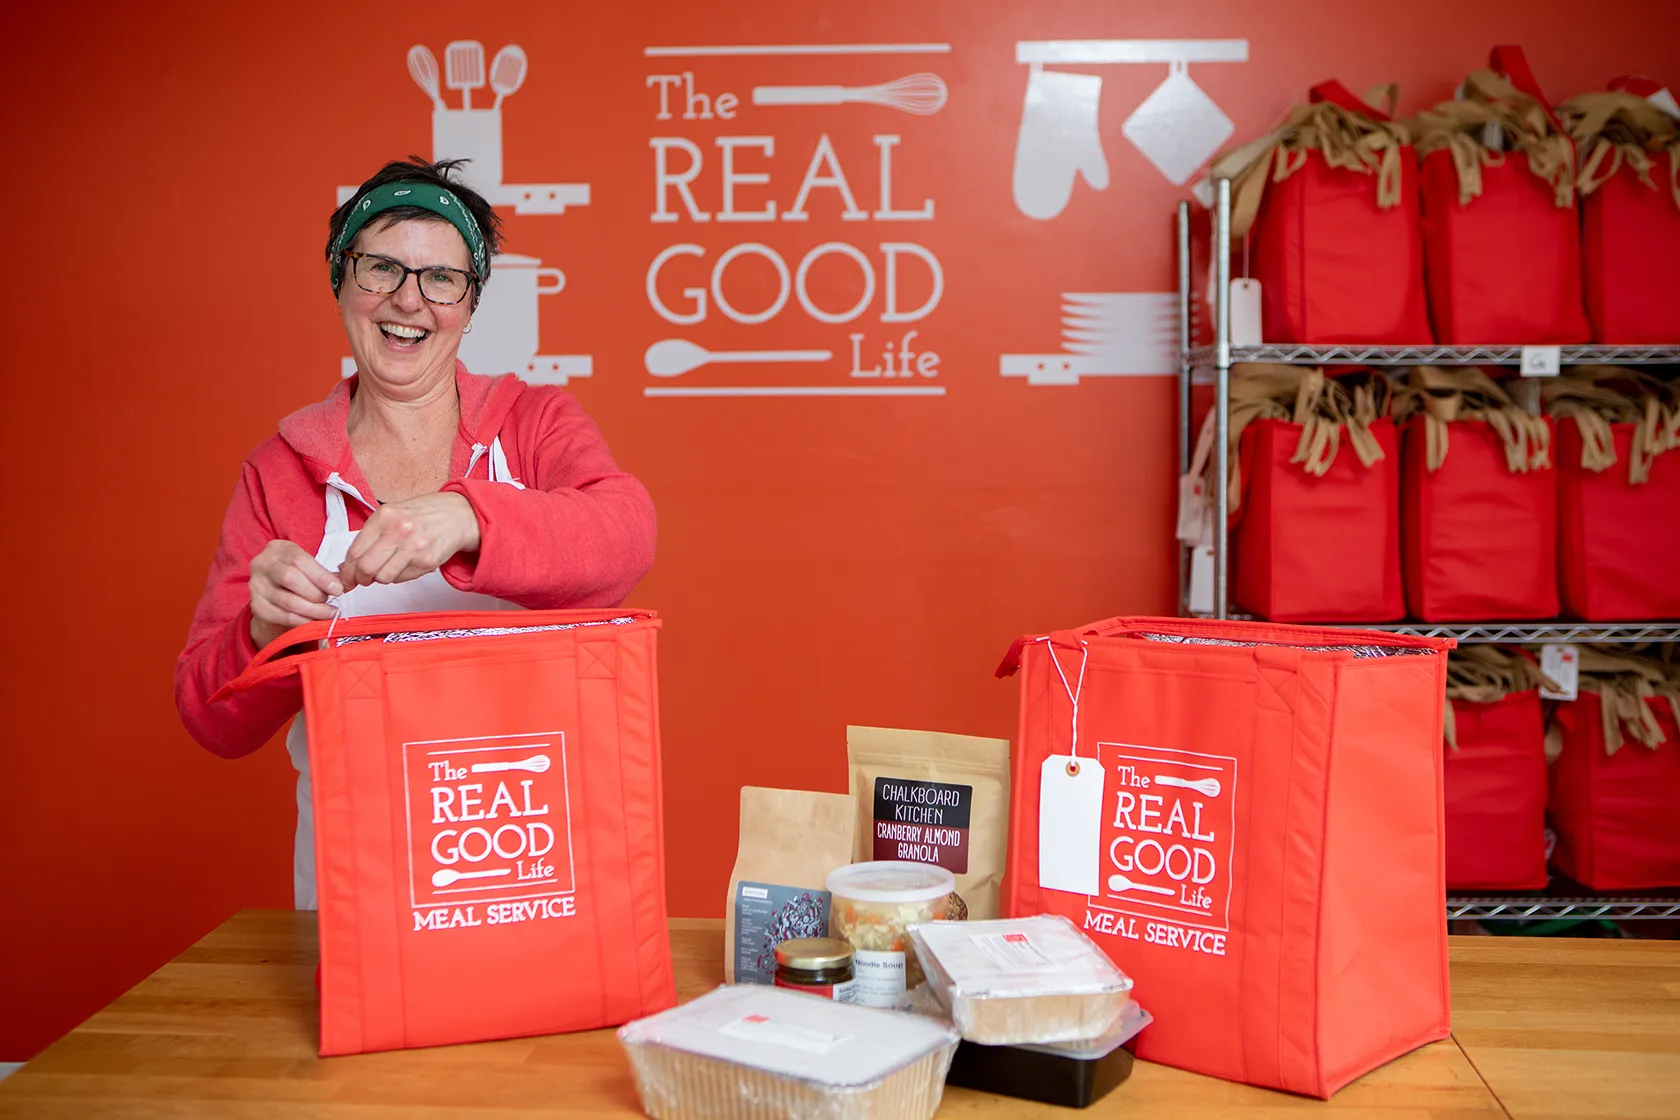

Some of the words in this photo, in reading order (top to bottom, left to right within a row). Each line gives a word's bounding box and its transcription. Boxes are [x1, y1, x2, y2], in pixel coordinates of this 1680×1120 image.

[646, 71, 740, 120] The
[649, 133, 935, 223] REAL
[645, 242, 944, 324] GOOD
[849, 330, 941, 378] Life
[428, 760, 467, 782] The
[1118, 766, 1150, 788] The
[430, 780, 548, 824] REAL
[882, 784, 960, 807] CHALKBOARD
[895, 804, 943, 824] KITCHEN
[1113, 791, 1215, 842] REAL
[431, 822, 554, 865] GOOD
[877, 822, 922, 842] CRANBERRY
[924, 828, 960, 847] ALMOND
[898, 842, 938, 862] GRANOLA
[516, 858, 555, 881] Life
[1110, 836, 1216, 884] GOOD
[413, 907, 482, 931] MEAL
[487, 896, 576, 925] SERVICE
[1180, 884, 1212, 908] Life
[1084, 910, 1139, 940] MEAL
[1144, 922, 1226, 956] SERVICE
[882, 962, 904, 970] Soup
